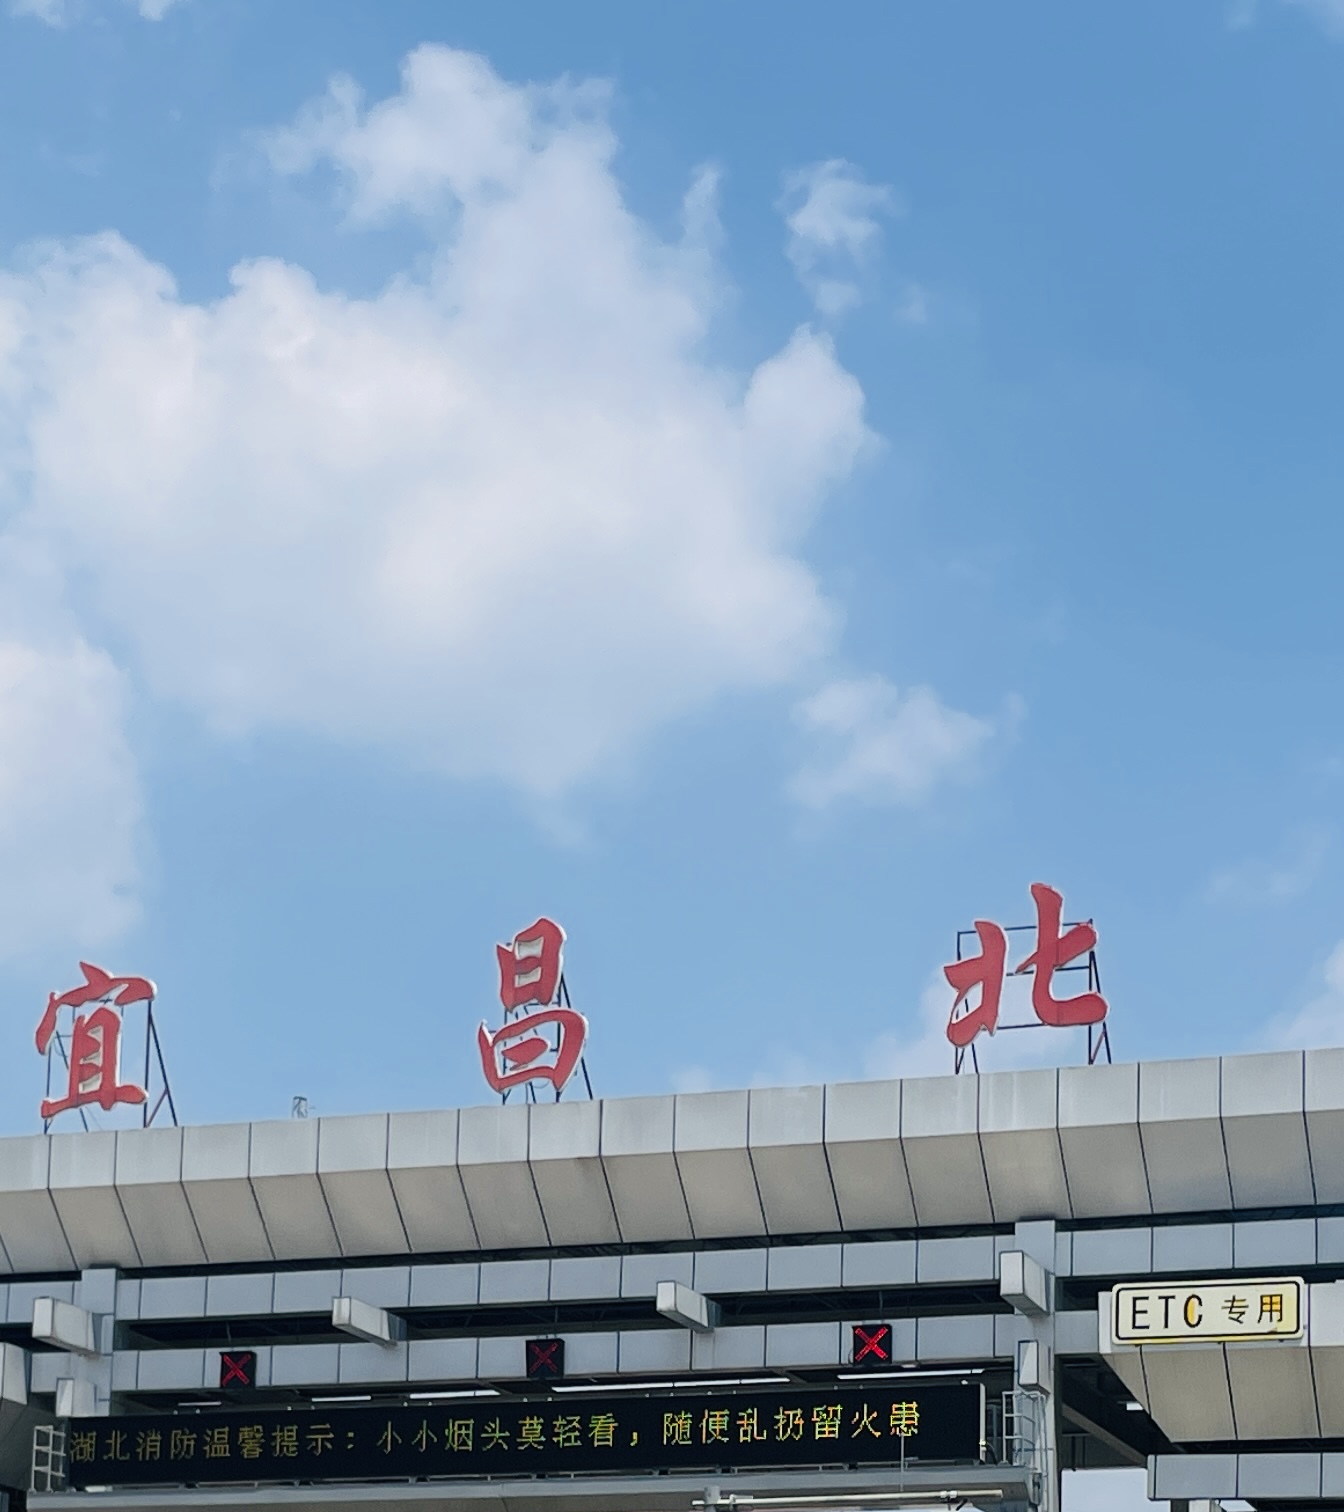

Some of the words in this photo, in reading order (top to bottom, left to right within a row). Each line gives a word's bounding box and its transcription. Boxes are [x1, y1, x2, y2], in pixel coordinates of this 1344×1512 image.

[35, 882, 1108, 1120] 宜昌北
[1131, 1294, 1203, 1329] ETC
[1221, 1294, 1284, 1324] 专用
